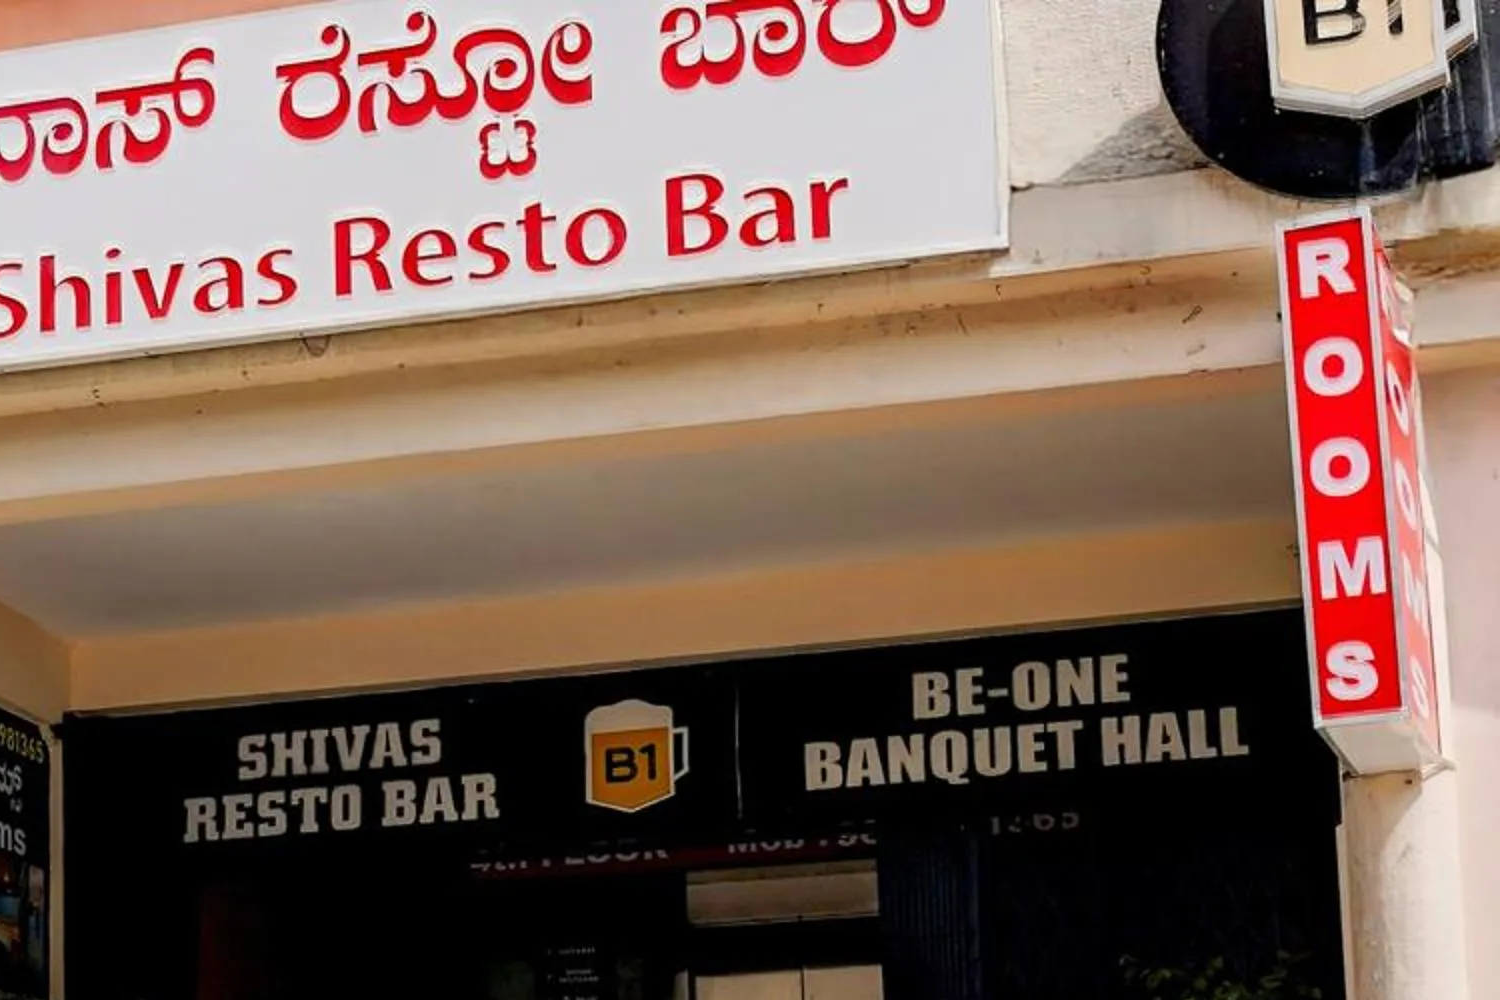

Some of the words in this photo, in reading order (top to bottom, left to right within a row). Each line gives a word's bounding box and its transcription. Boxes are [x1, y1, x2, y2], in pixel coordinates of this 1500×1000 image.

[276, 11, 593, 179] ರೆಸ್ಟೋ
[333, 202, 627, 296] Resto
[666, 174, 849, 257] Bar
[1296, 236, 1387, 701] ROOMS
[911, 653, 1131, 721] BE-ONE
[237, 718, 442, 781] SHIVAS
[603, 742, 659, 784] B1
[803, 720, 1084, 791] BANQUET
[1100, 706, 1250, 767] HALL
[182, 783, 361, 843] RESTO
[381, 772, 501, 828] BAR
